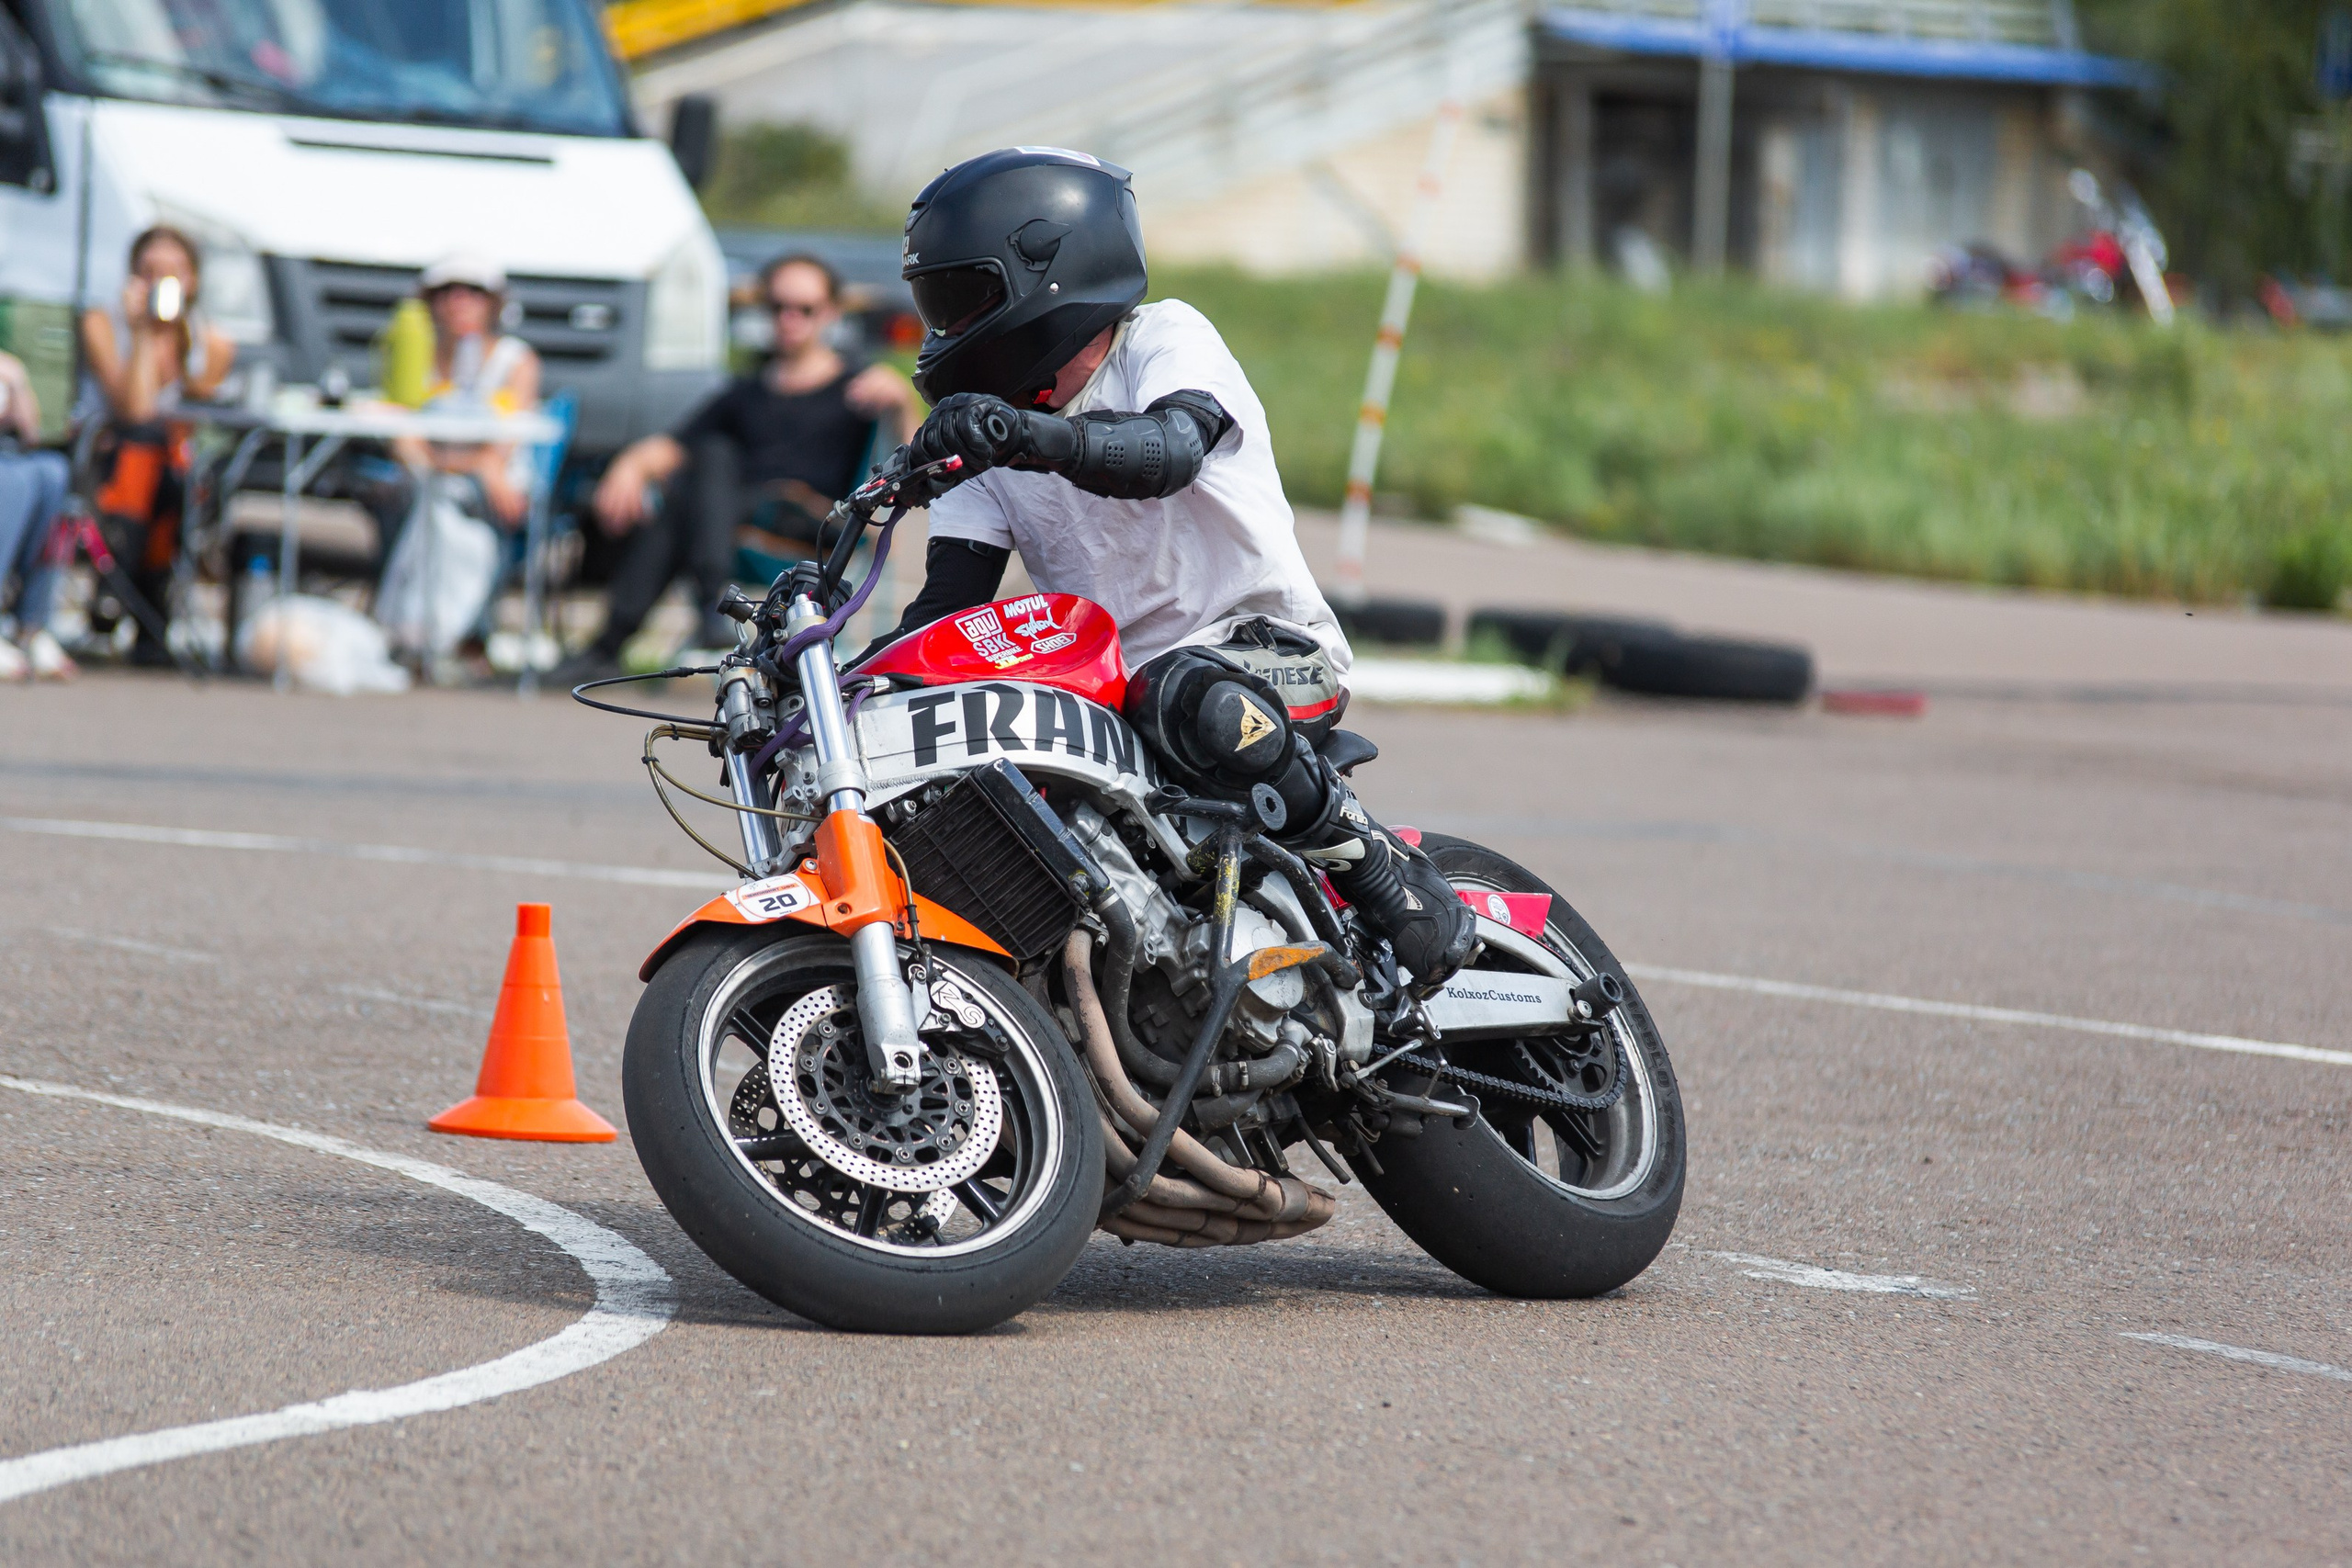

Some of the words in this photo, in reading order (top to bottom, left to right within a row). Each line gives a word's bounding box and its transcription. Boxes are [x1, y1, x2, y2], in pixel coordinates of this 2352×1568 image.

[902, 252, 920, 266] ARK
[1002, 594, 1048, 619] MOTUL
[1013, 607, 1062, 640] SHARK
[972, 632, 1016, 657] SBK
[1035, 635, 1072, 652] SHOEI
[985, 645, 1023, 662] SUPERBIKE
[758, 893, 797, 912] 20
[1446, 987, 1543, 1004] KolxozCustoms
